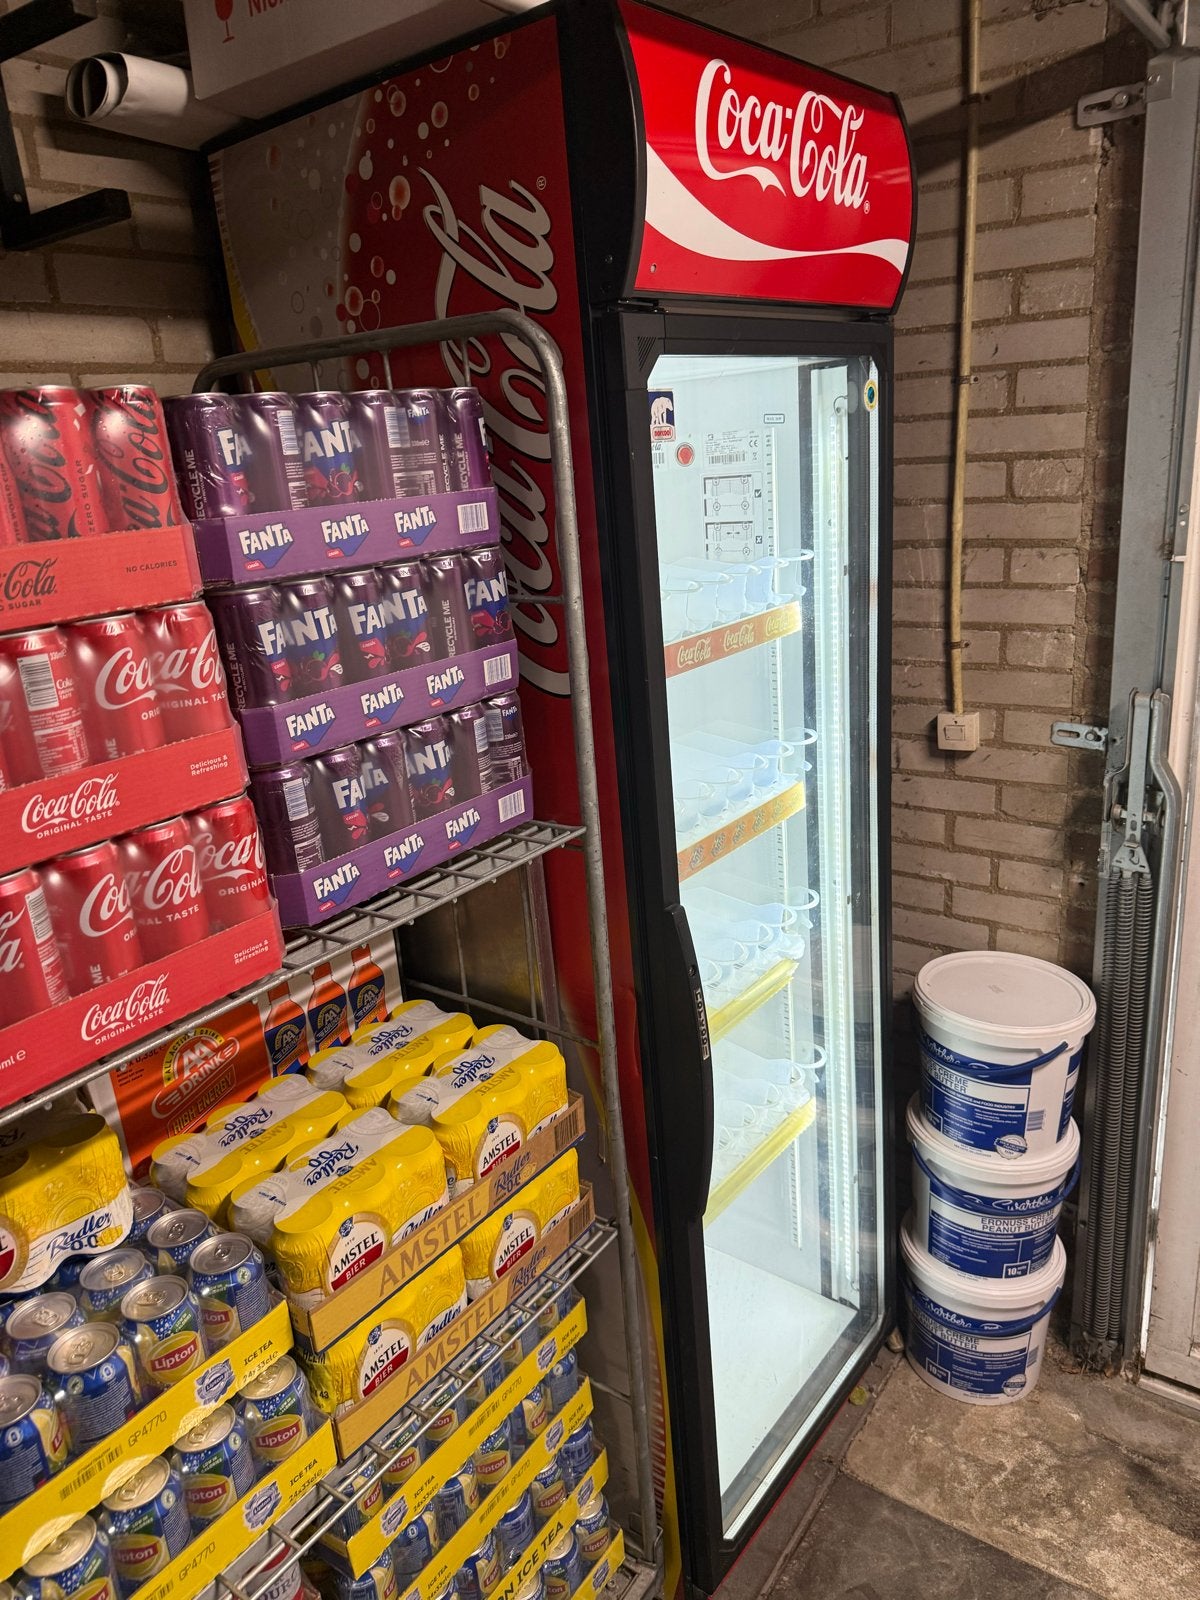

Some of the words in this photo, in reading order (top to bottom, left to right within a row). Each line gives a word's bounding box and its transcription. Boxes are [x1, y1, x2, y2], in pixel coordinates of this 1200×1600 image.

[695, 58, 871, 210] Coca-Cola
[184, 449, 194, 470] ME
[321, 514, 369, 543] FANTA
[394, 506, 437, 533] FANTA
[239, 522, 293, 555] FANTA
[126, 566, 139, 574] NO
[140, 559, 178, 573] CALORIES
[464, 570, 508, 610] FAN
[441, 599, 451, 615] ME
[678, 637, 713, 668] Coca-Cola
[723, 624, 756, 652] Coca-Cola
[427, 666, 465, 695] FANTA
[361, 683, 404, 714] FANTA
[286, 703, 336, 737] FANTA
[190, 757, 221, 771] Delicious
[191, 761, 229, 777] Refreshing
[22, 772, 119, 834] Coca-Cola
[36, 820, 82, 840] ORIGINAL
[84, 810, 113, 825] TASTE
[445, 807, 481, 839] FANTA
[383, 833, 424, 867] FANTA
[313, 863, 360, 900] FANTA
[166, 903, 200, 923] TASTE
[233, 941, 263, 959] Delicious
[234, 946, 269, 965] Refreshing
[81, 972, 170, 1042] Coca-Cola
[94, 1021, 137, 1046] ORIGINAL
[138, 1007, 165, 1026] TASTE
[368, 1025, 413, 1056] Radler
[181, 1052, 226, 1096] DRINK
[182, 1041, 216, 1079] AA
[451, 1054, 496, 1089] Radler
[934, 1072, 967, 1094] BUTTER
[938, 1065, 969, 1087] CREME
[172, 1101, 198, 1136] HIGH
[197, 1070, 236, 1120] ENERGY
[217, 1107, 273, 1148] Radler
[303, 1142, 359, 1186] Radler
[482, 1131, 518, 1169] AMSTEL
[46, 1212, 113, 1258] Radler
[981, 1217, 1029, 1228] ERDNUSS
[982, 1223, 1023, 1234] PEANUT
[333, 1231, 379, 1277] AMSTEL
[379, 1195, 482, 1297] AMSTEL
[498, 1227, 533, 1266] AMSTEL
[506, 1250, 522, 1268] BIER
[346, 1259, 366, 1281] BIER
[1006, 1266, 1017, 1277] 10
[204, 1311, 226, 1323] ton
[404, 1294, 500, 1399] AMSTEL
[941, 1333, 978, 1351] BUTTER
[944, 1331, 980, 1345] CREME
[155, 1344, 196, 1369] Lipton
[244, 1353, 258, 1366] ICE
[258, 1340, 273, 1355] TEA
[363, 1339, 405, 1386] AMSTEL
[374, 1364, 394, 1386] BIER
[128, 1410, 168, 1448] GP4770
[258, 1426, 297, 1446] Lipton
[289, 1471, 303, 1487] ICE
[304, 1458, 318, 1472] TEA
[389, 1455, 414, 1473] pton
[477, 1458, 507, 1475] Lipton
[413, 1487, 425, 1499] ICE
[424, 1475, 436, 1489] TEA
[516, 1552, 540, 1579] ICE
[540, 1521, 563, 1553] TEA
[584, 1534, 609, 1554] Lipton
[178, 1541, 216, 1581] GP4770
[427, 1574, 438, 1590] ICE
[437, 1565, 449, 1578] TEA
